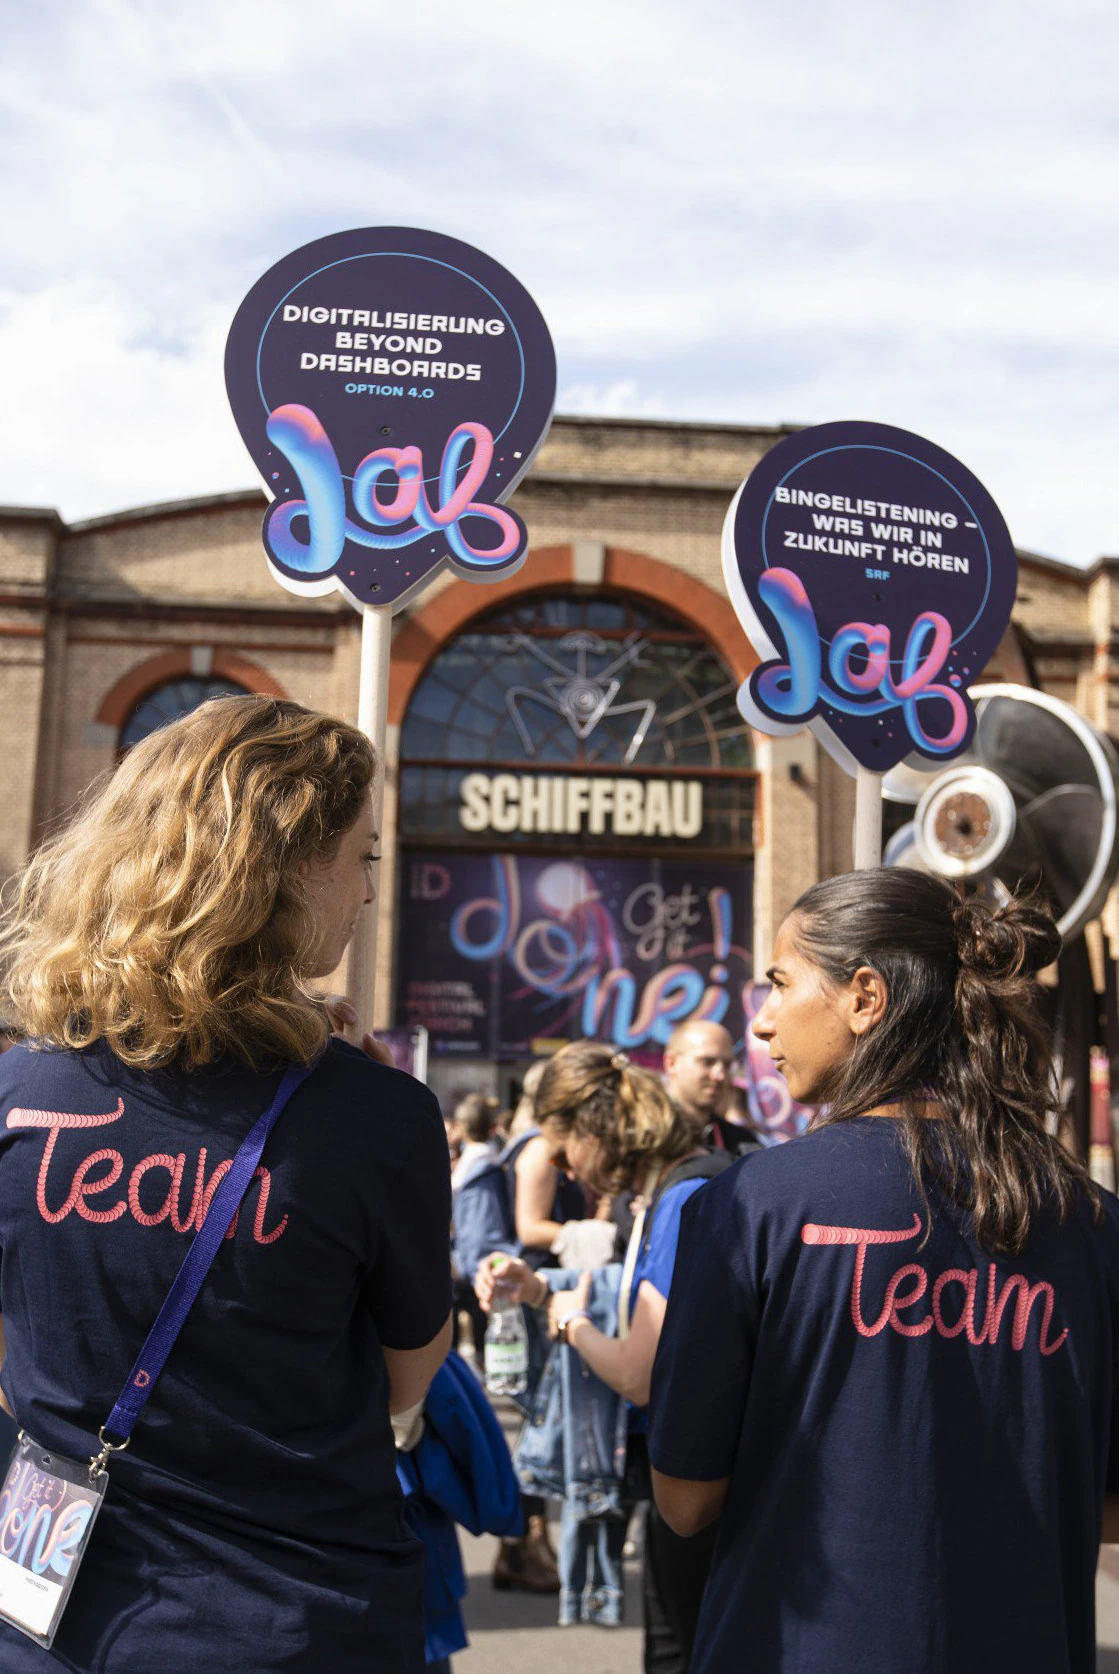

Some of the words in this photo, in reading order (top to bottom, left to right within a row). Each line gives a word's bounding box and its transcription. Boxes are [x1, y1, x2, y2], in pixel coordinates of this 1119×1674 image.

[282, 304, 506, 336] DIGITALISIERUNG
[335, 331, 443, 355] BEYOND
[300, 352, 482, 381] DASHBOARDS
[344, 382, 404, 398] OPTION
[407, 385, 435, 400] 4.0
[775, 486, 958, 529] BINGELISTENING
[812, 513, 864, 536] WAS
[870, 521, 913, 545] WIR
[920, 529, 943, 549] IN
[783, 531, 887, 561] ZUKUNFT
[893, 545, 969, 574] HÖREN
[865, 567, 891, 582] SRF
[459, 773, 703, 838] SCHIFFBAU
[6, 1097, 289, 1245] Team
[801, 1213, 1069, 1356] Team
